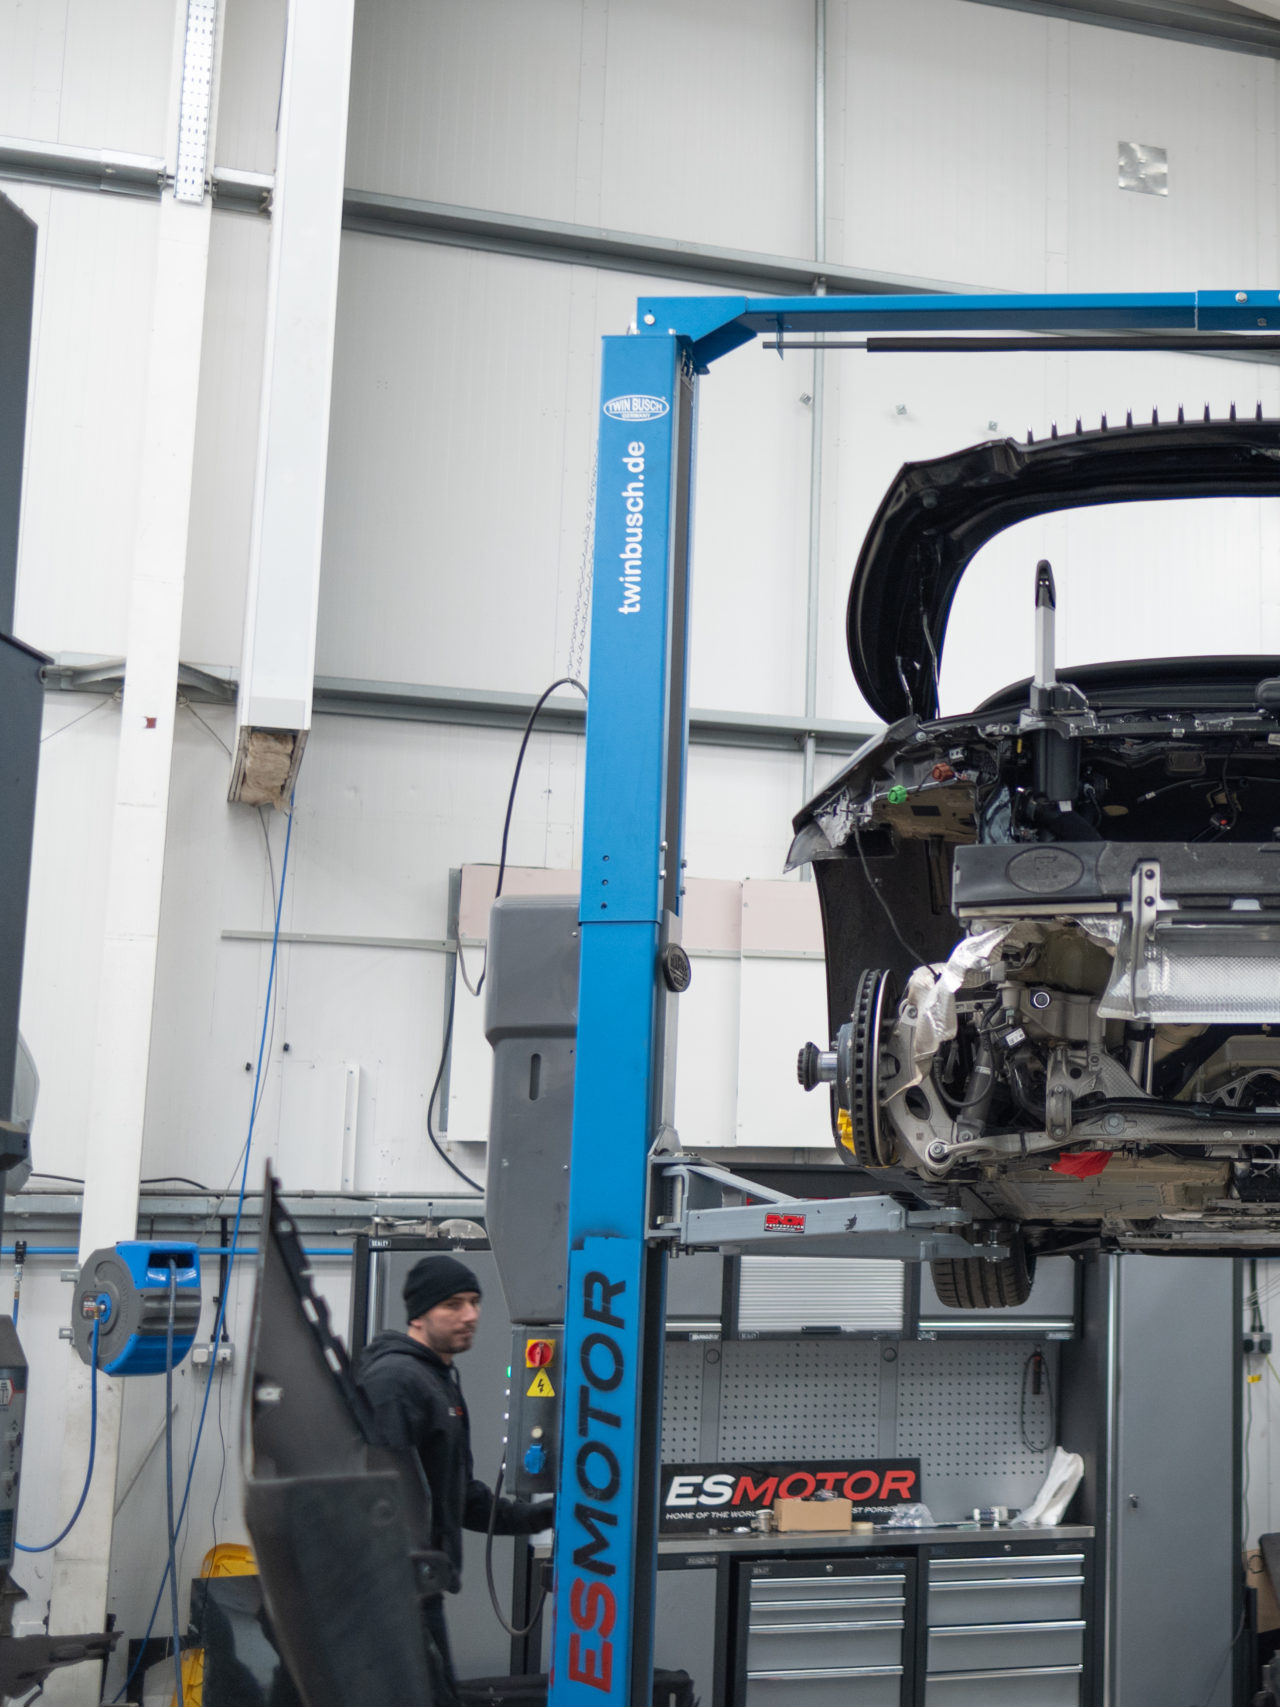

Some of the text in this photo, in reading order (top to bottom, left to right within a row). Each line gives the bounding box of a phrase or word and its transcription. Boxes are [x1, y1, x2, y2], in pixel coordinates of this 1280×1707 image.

[608, 397, 663, 412] TWIN BUSCH
[618, 440, 646, 615] twinbusch.de
[568, 1271, 627, 1694] ESMOTOR
[665, 1470, 916, 1507] ESMOTOR
[730, 1510, 757, 1518] WORL
